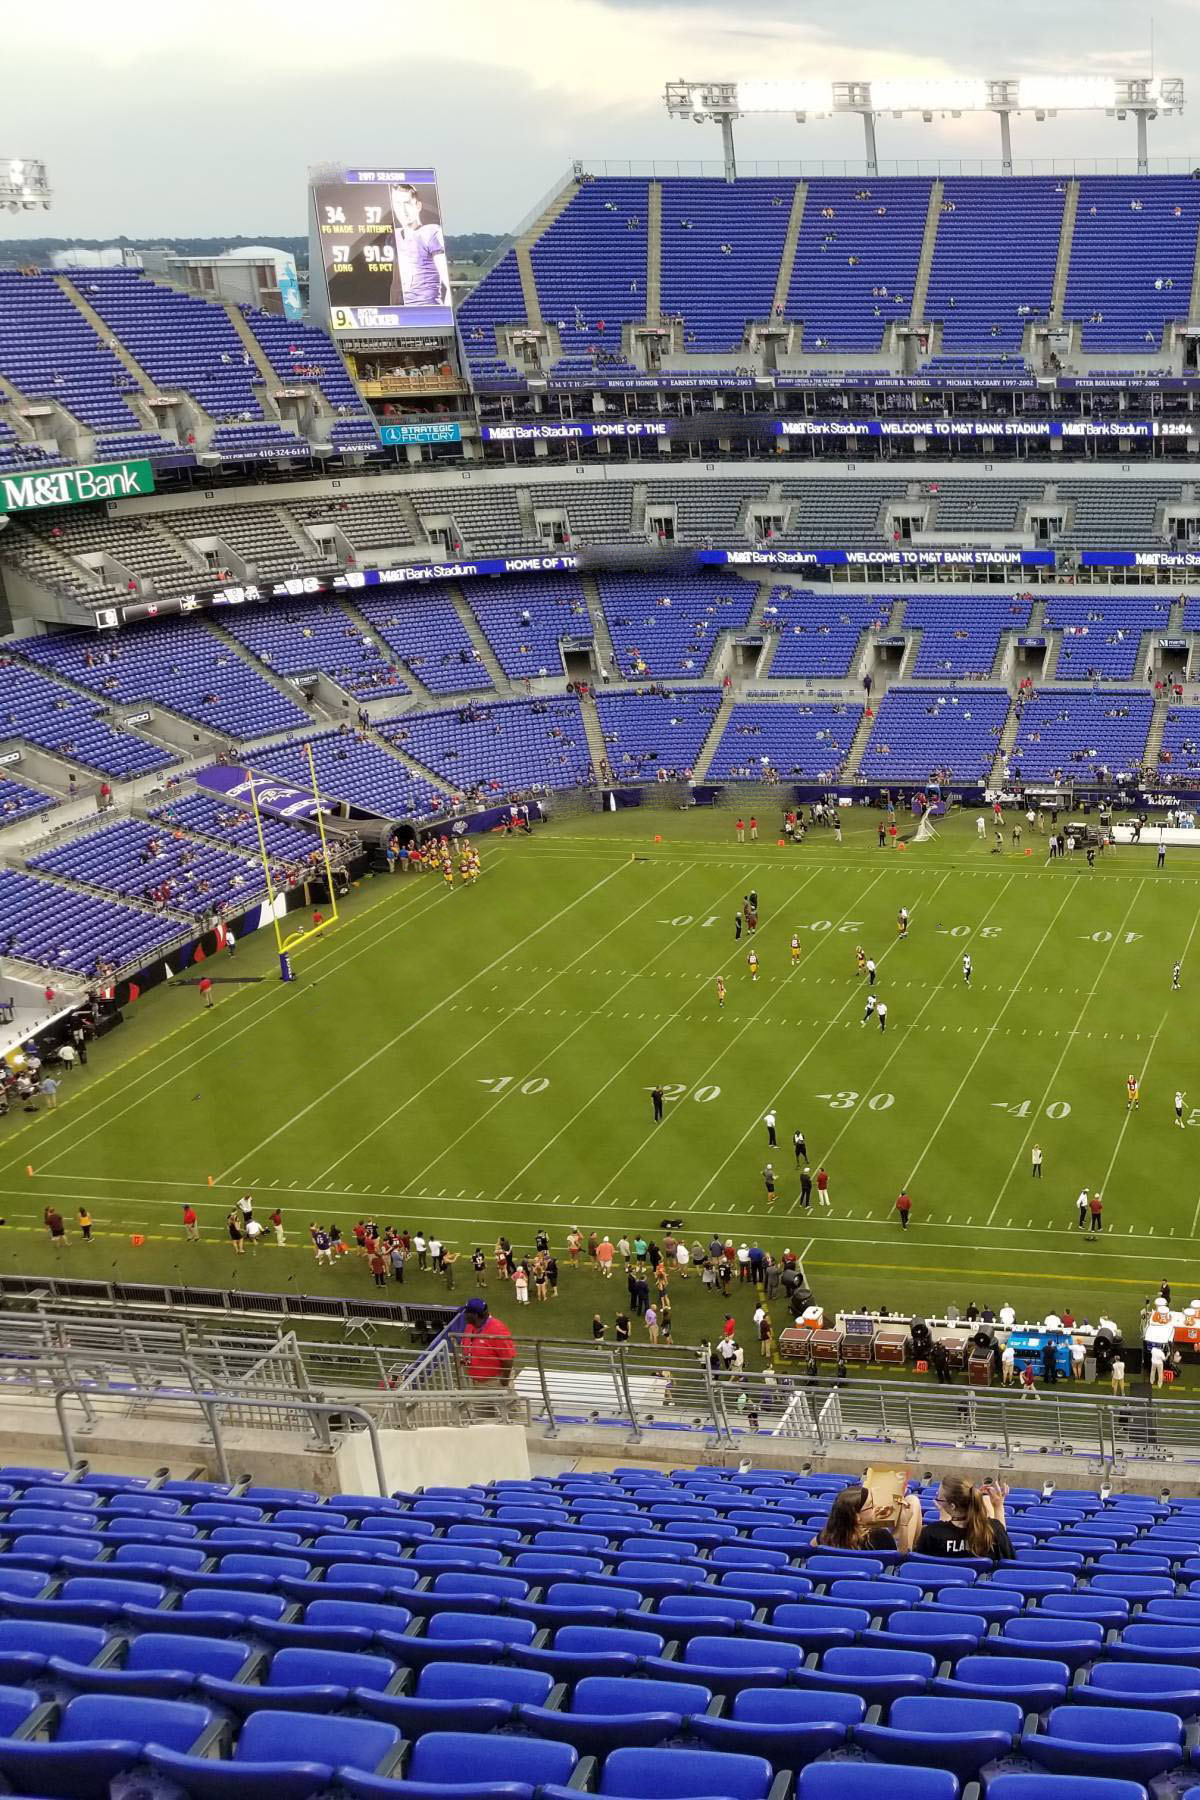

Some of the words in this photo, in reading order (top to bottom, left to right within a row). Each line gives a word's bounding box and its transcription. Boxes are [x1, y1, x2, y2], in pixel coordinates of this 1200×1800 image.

[325, 206, 346, 224] 34
[364, 206, 382, 224] 37
[322, 225, 332, 234] FG
[334, 225, 354, 234] MADE
[367, 225, 393, 234] ATTEMPTS
[332, 246, 350, 263] 57
[363, 245, 394, 263] 91.9
[334, 264, 353, 273] LONG
[368, 264, 378, 272] FG
[379, 263, 393, 273] PCT
[336, 309, 347, 326] 9
[1075, 379, 1094, 387] PETER
[401, 424, 453, 433] STRATEGIC
[490, 427, 515, 438] M&T
[516, 426, 540, 437] Bank
[541, 424, 582, 437] Stadium
[592, 424, 624, 435] HOME
[627, 424, 641, 435] OF
[644, 424, 666, 435] THE
[782, 423, 806, 434] M&T
[807, 423, 831, 434] Bank
[834, 422, 869, 435] Stadium
[880, 424, 932, 434] WELCOME
[934, 424, 949, 434] TO
[951, 424, 973, 434] M&T
[975, 424, 1003, 434] BANK
[1005, 424, 1049, 434] STADIUM
[1087, 424, 1109, 435] Bank
[1111, 424, 1147, 435] Stadium
[402, 432, 454, 441] FACTORY
[259, 448, 309, 458] 410-324-6141
[339, 444, 377, 452] RAVENS
[1, 472, 74, 510] M&T
[75, 465, 141, 500] Bank
[727, 552, 752, 563] M&T
[753, 552, 776, 563] Bank
[778, 552, 816, 563] Stadium
[846, 552, 900, 563] WELCOME
[902, 552, 917, 563] TO
[920, 552, 942, 563] M&T
[945, 552, 973, 563] BANK
[976, 552, 1020, 563] STADIUM
[1161, 554, 1184, 565] Bank
[506, 559, 540, 571] HOME
[543, 558, 558, 569] OF
[379, 569, 405, 582] M&T
[406, 567, 433, 580] Bank
[434, 564, 476, 577] Stadium
[917, 1362, 926, 1371] 40
[1164, 1371, 1173, 1381] 50
